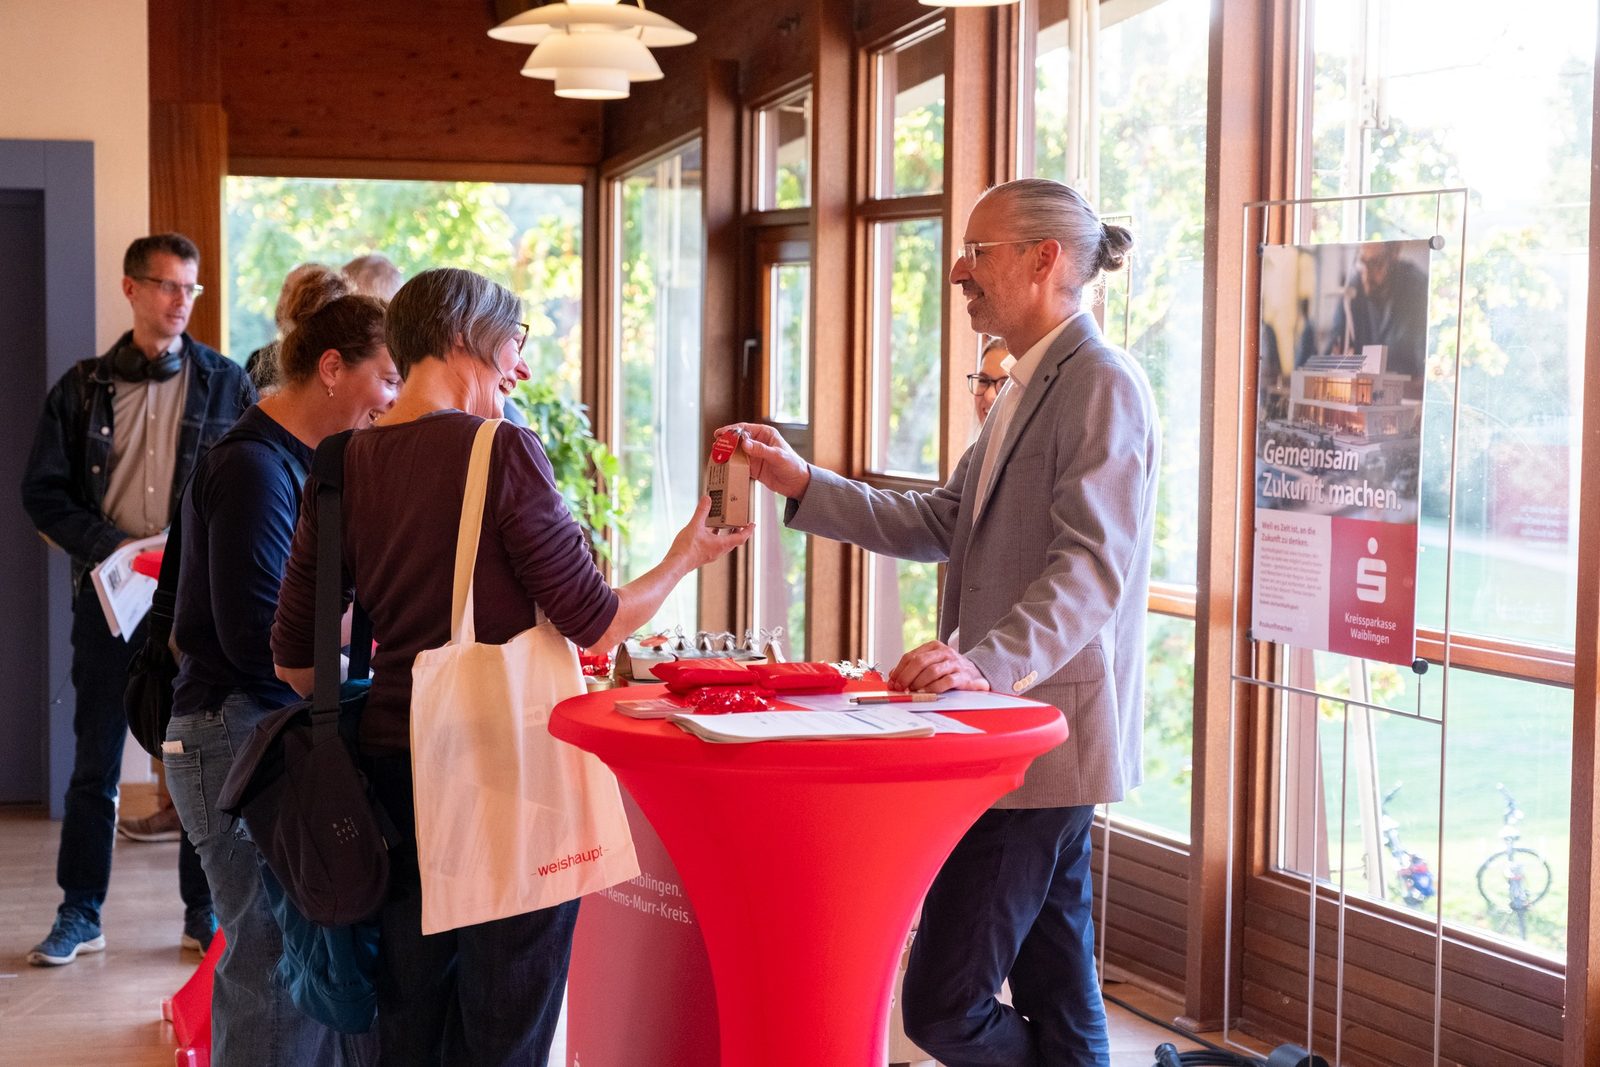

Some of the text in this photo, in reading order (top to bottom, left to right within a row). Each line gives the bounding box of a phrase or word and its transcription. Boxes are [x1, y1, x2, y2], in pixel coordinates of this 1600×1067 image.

[1263, 439, 1359, 471] Gemeinsam
[1262, 472, 1402, 510] Zukunft machen.
[1344, 612, 1397, 630] Kreissparkasse
[1350, 628, 1390, 645] Waiblingen
[626, 872, 682, 897] aiblingen.
[608, 887, 692, 924] Rems-Murr-Kreis.
